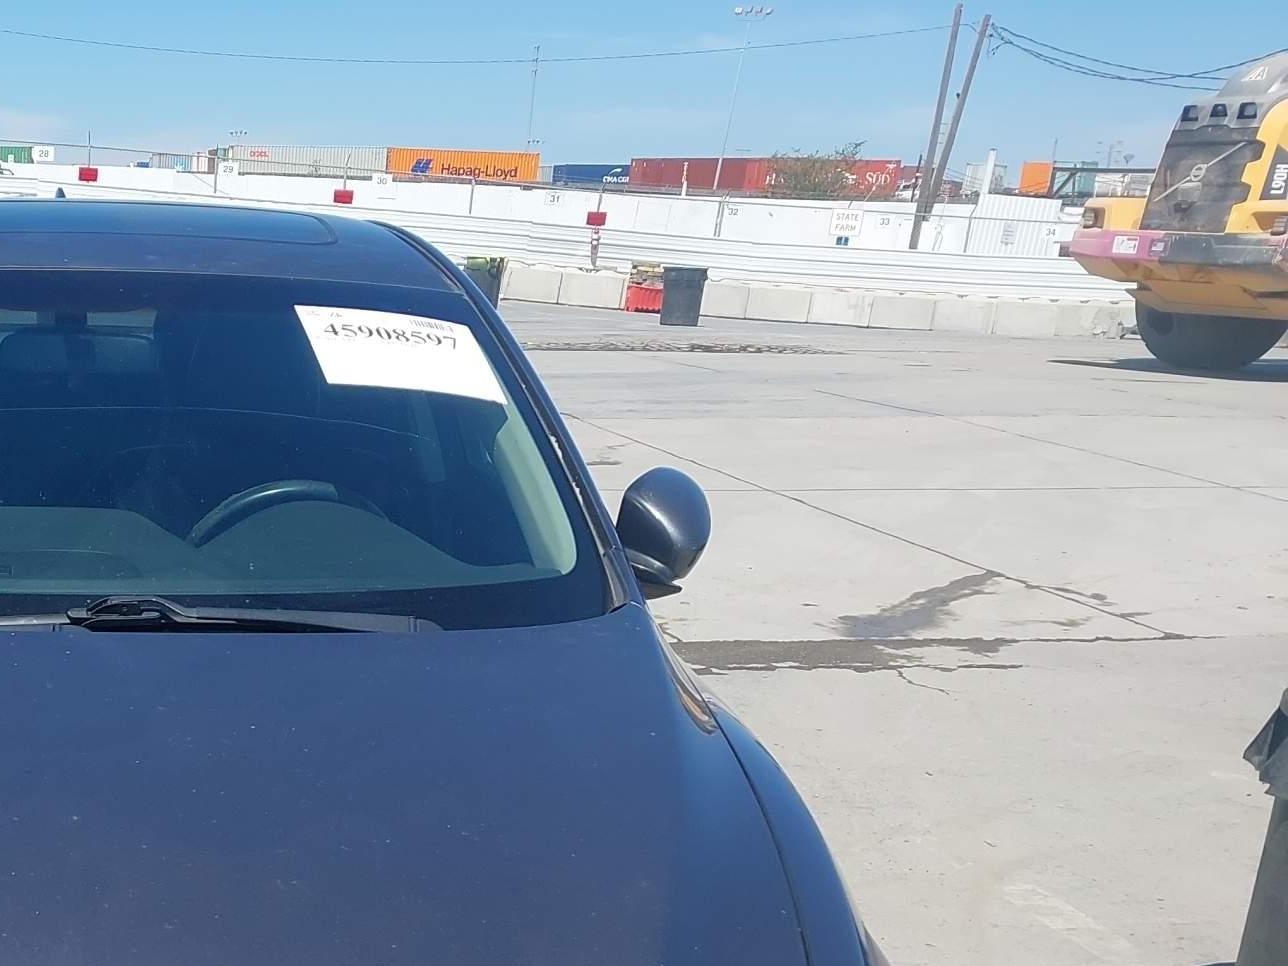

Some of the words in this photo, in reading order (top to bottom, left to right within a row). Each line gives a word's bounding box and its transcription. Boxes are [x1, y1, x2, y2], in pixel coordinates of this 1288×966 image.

[38, 148, 50, 159] 28
[223, 165, 234, 175] 29
[441, 162, 518, 181] Hapag-Lloyd
[376, 176, 388, 186] 30
[1270, 163, 1288, 194] L90H
[549, 194, 560, 204] 31
[728, 207, 739, 217] 32
[835, 212, 860, 222] STATE
[879, 217, 890, 226] 33
[834, 223, 857, 232] FARM
[1045, 227, 1056, 237] 34
[323, 322, 457, 350] 45908597
